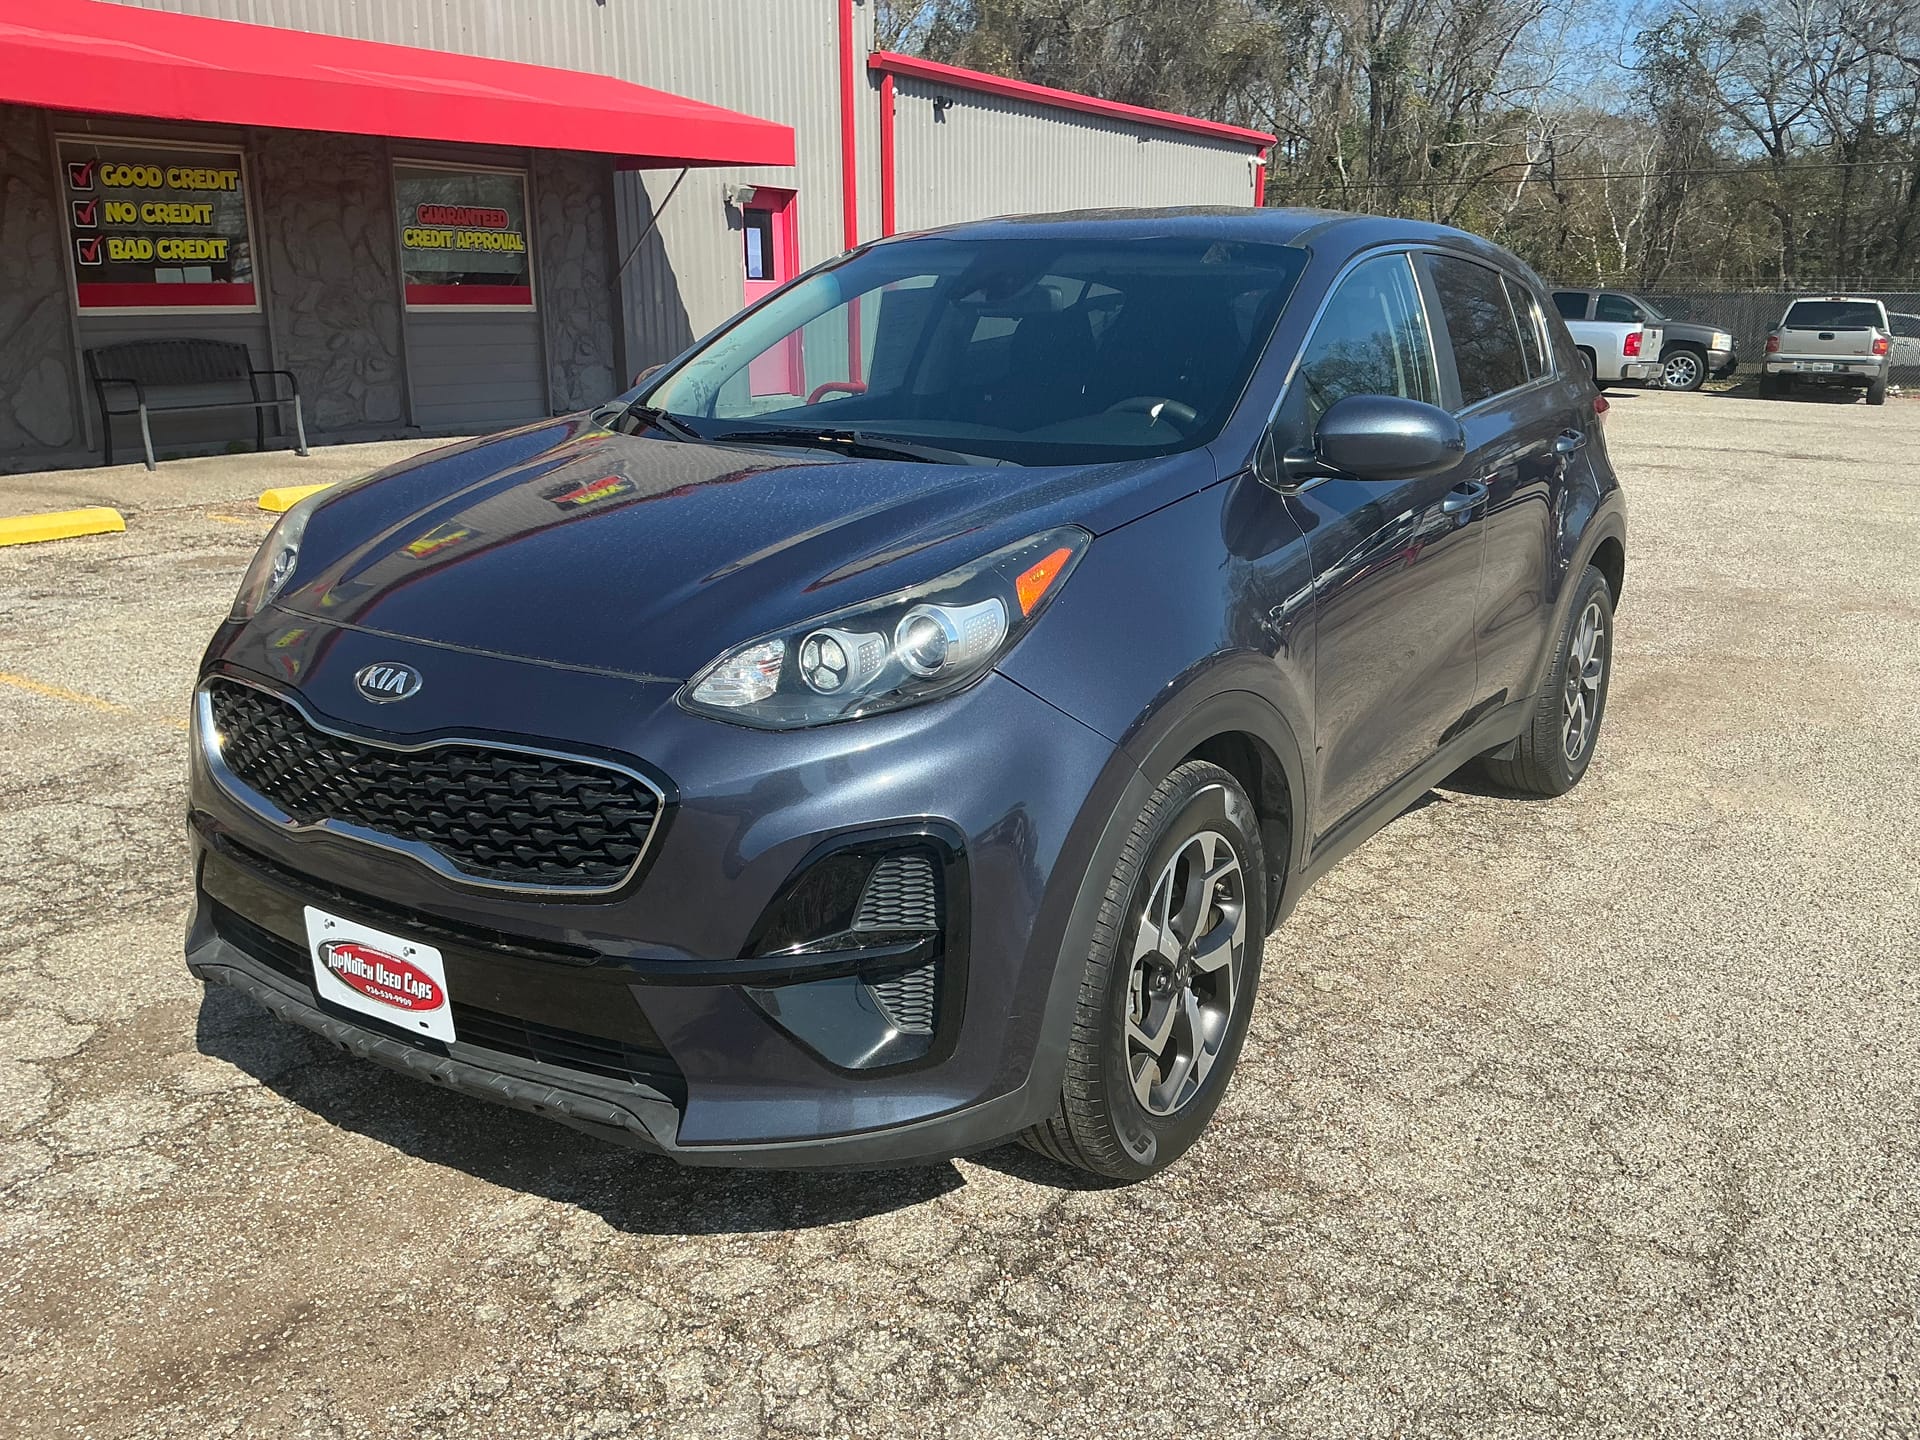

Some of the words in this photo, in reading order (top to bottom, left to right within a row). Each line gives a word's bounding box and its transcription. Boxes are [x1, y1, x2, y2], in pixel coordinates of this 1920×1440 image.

[100, 166, 163, 187] GOOD
[167, 168, 239, 190] CREDIT
[105, 202, 137, 223] NO
[141, 204, 212, 224] CREDIT
[418, 205, 505, 227] GUARANTEED
[108, 239, 153, 259] BAD
[157, 240, 227, 260] CREDIT
[403, 229, 453, 247] CREDIT
[456, 231, 524, 251] APPROVAL
[361, 666, 408, 693] KIA
[376, 963, 401, 990] USED
[404, 973, 432, 999] CARS
